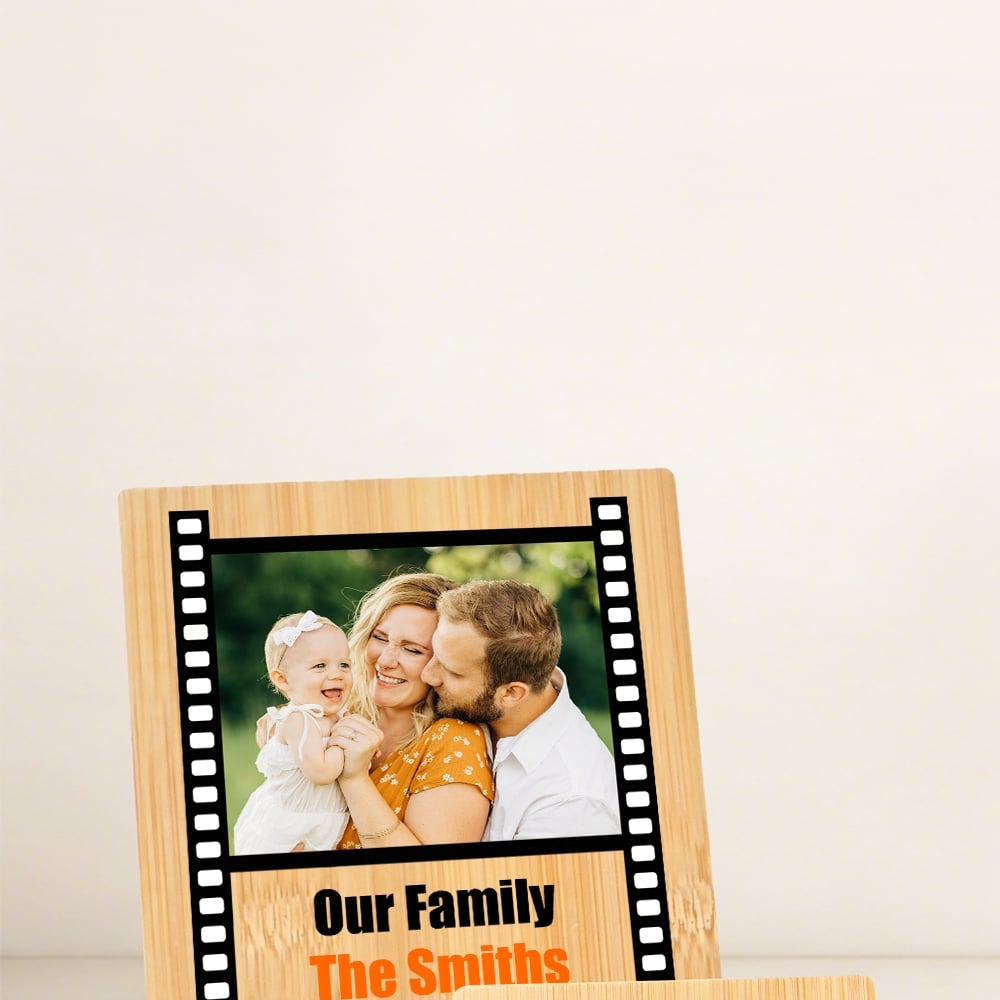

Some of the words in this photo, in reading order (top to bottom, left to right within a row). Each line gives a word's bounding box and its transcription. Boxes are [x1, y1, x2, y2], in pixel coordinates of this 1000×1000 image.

[313, 888, 395, 937] Our
[404, 878, 555, 931] Family
[407, 942, 571, 996] Smiths
